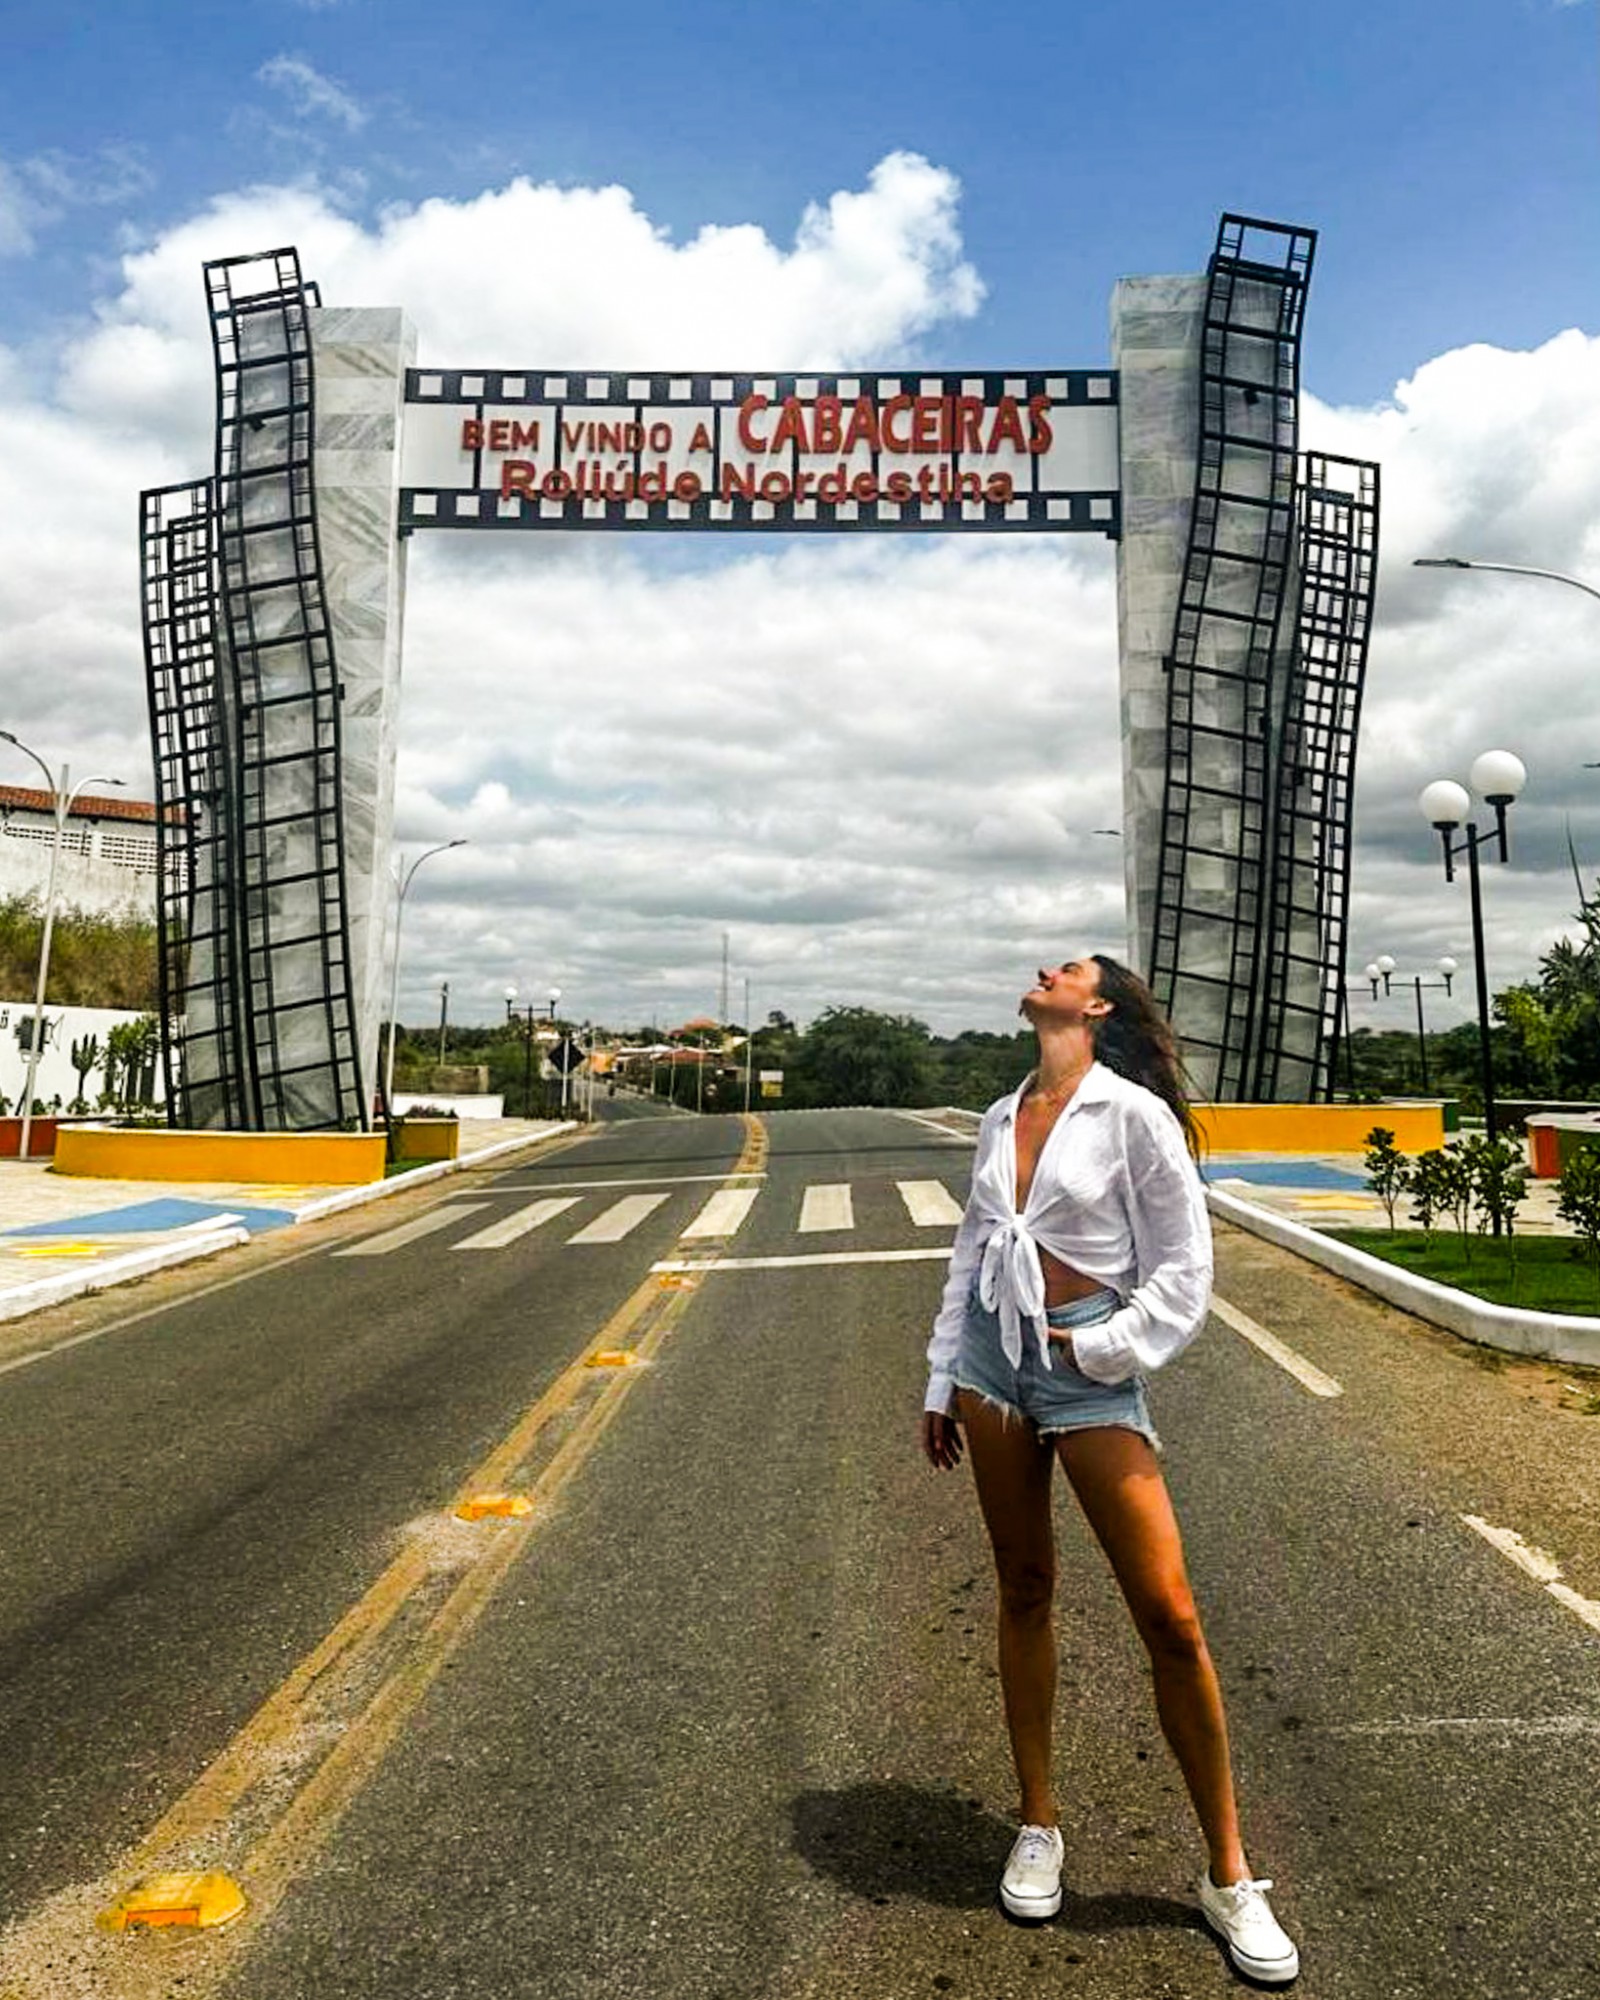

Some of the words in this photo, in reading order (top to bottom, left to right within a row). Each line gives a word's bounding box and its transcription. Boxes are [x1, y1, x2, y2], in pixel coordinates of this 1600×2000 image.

[462, 418, 540, 451] BEM
[561, 420, 674, 453] VINDO
[687, 421, 713, 453] A
[738, 394, 1053, 454] CABACEIRAS
[501, 459, 702, 503] Roliúde
[721, 461, 1015, 505] Nordestina
